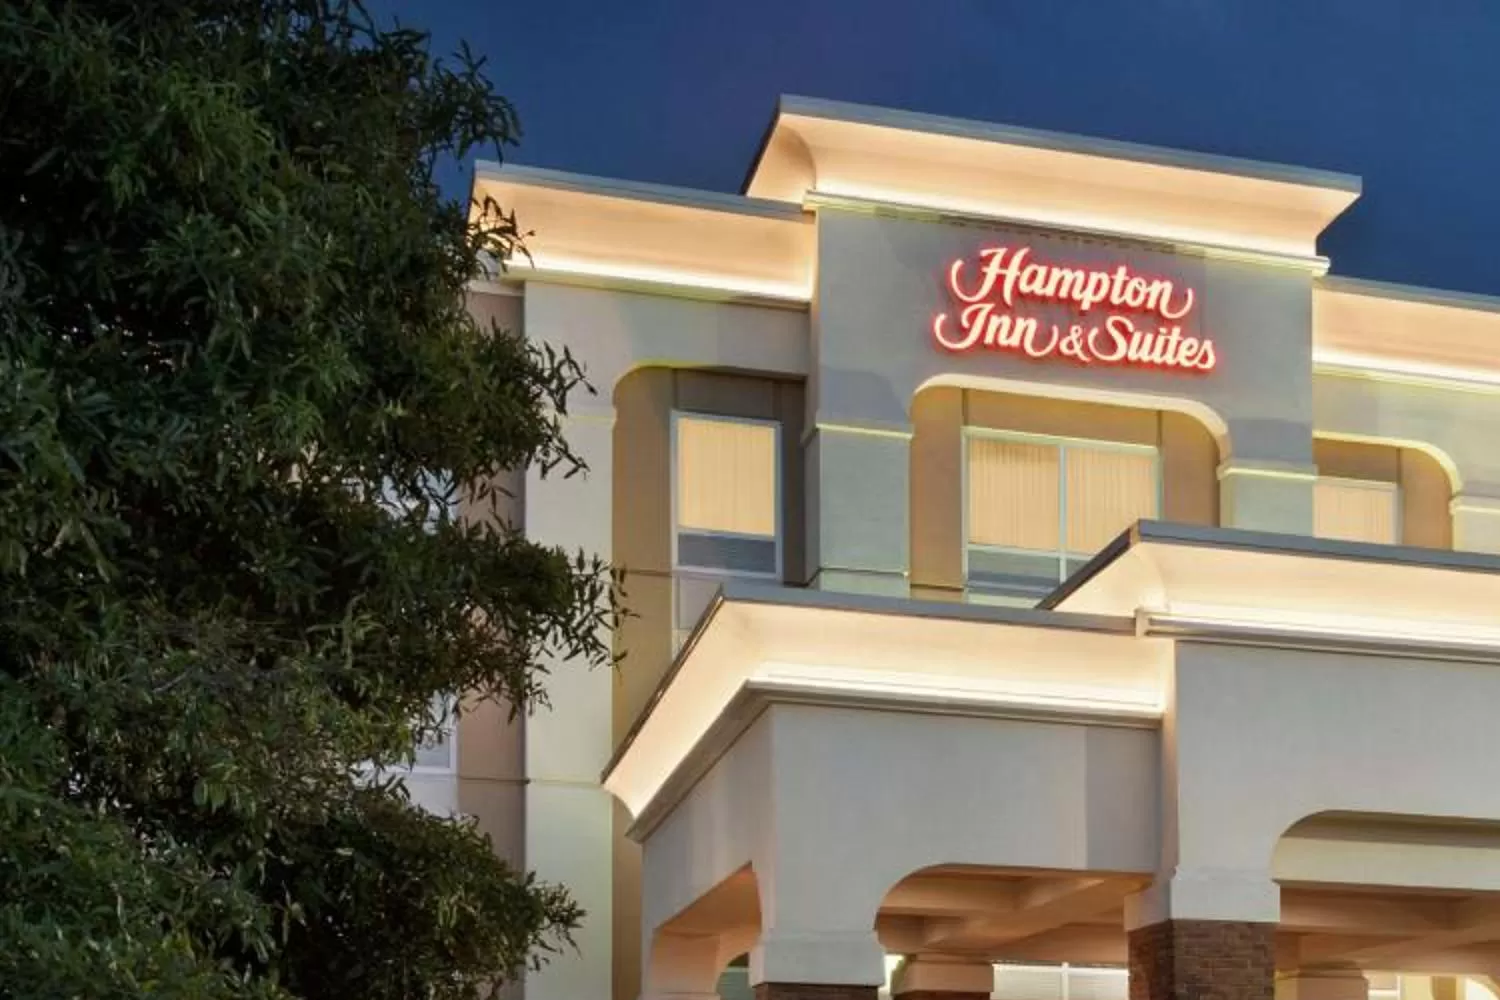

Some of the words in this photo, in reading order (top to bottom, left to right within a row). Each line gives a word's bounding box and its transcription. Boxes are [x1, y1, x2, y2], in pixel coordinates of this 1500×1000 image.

[951, 246, 1194, 319] Hampton
[934, 303, 1058, 357] Inn
[1059, 325, 1091, 362] &
[1088, 315, 1217, 369] Suites
